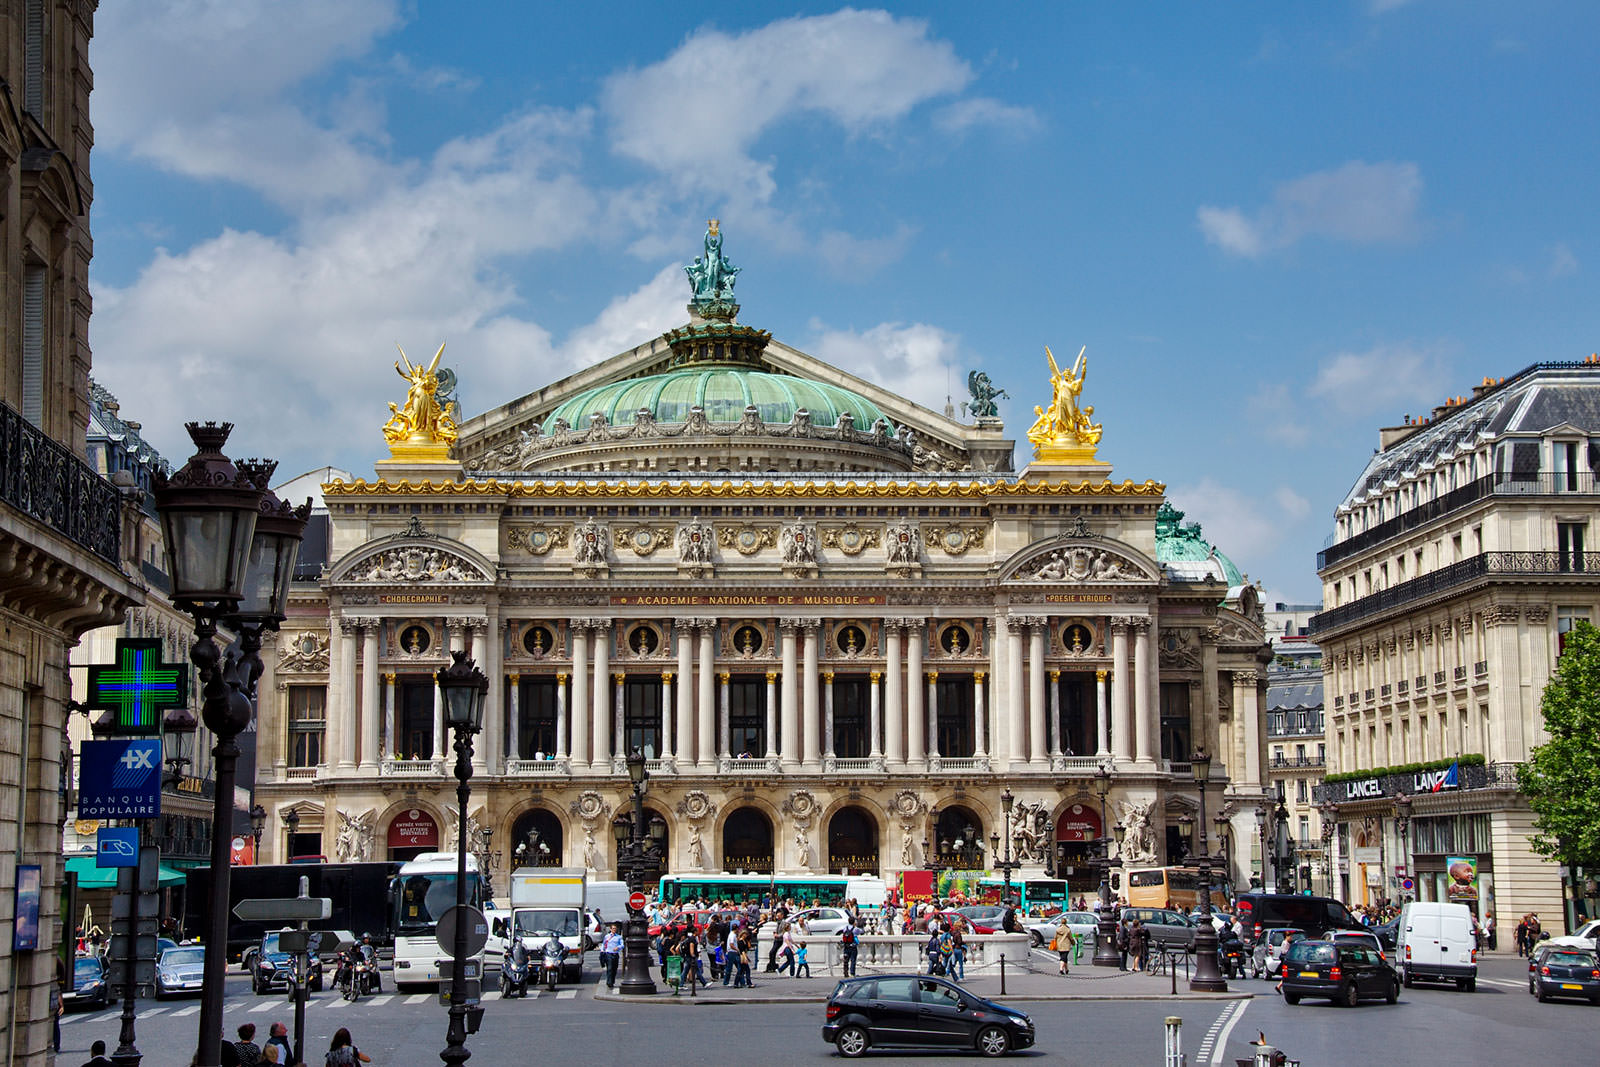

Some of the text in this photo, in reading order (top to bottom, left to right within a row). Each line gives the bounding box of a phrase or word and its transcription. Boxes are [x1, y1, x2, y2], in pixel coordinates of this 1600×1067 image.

[637, 596, 859, 605] ACADEMIE NATIONALE DE MUSIQUE
[1346, 780, 1382, 798] LANCEL
[82, 795, 154, 804] BANQUE
[82, 806, 154, 814] POPULAIRE
